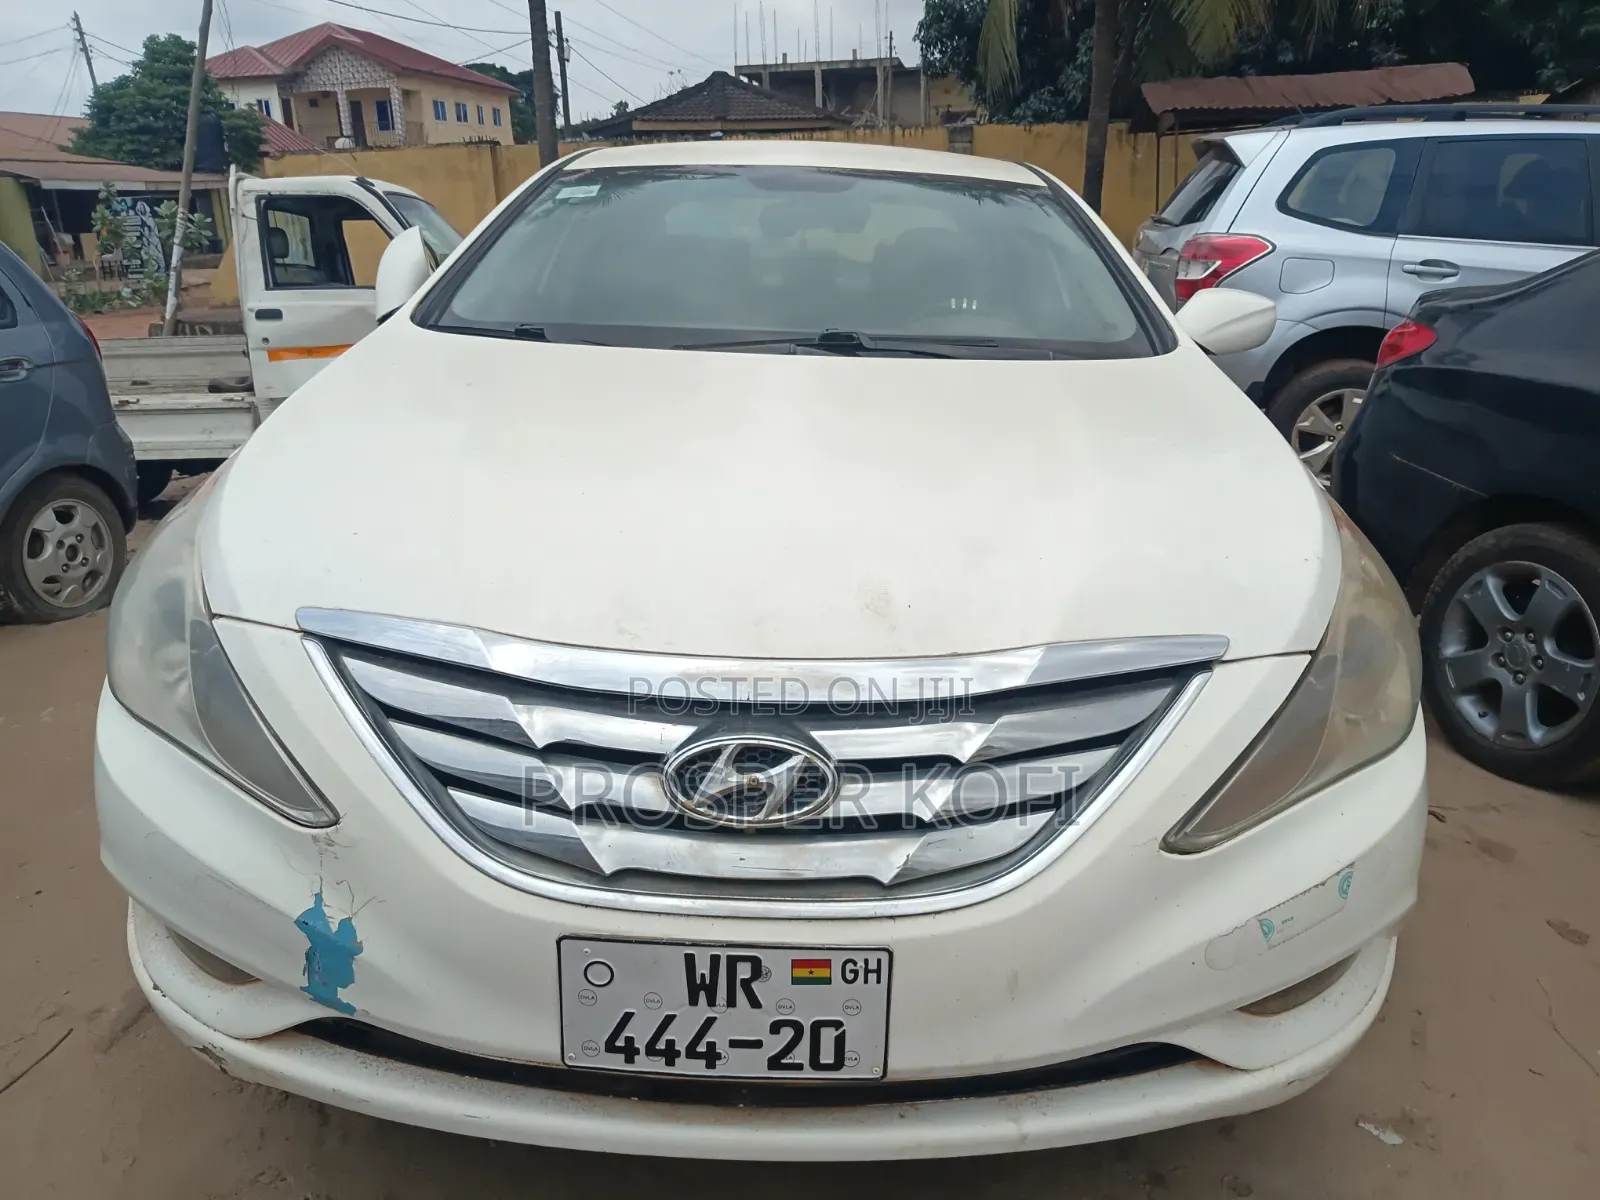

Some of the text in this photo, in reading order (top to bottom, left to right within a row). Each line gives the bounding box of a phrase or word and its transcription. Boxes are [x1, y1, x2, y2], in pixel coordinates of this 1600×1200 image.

[683, 952, 763, 1009] WR
[840, 958, 881, 985] GH
[604, 1012, 846, 1071] 444-20
